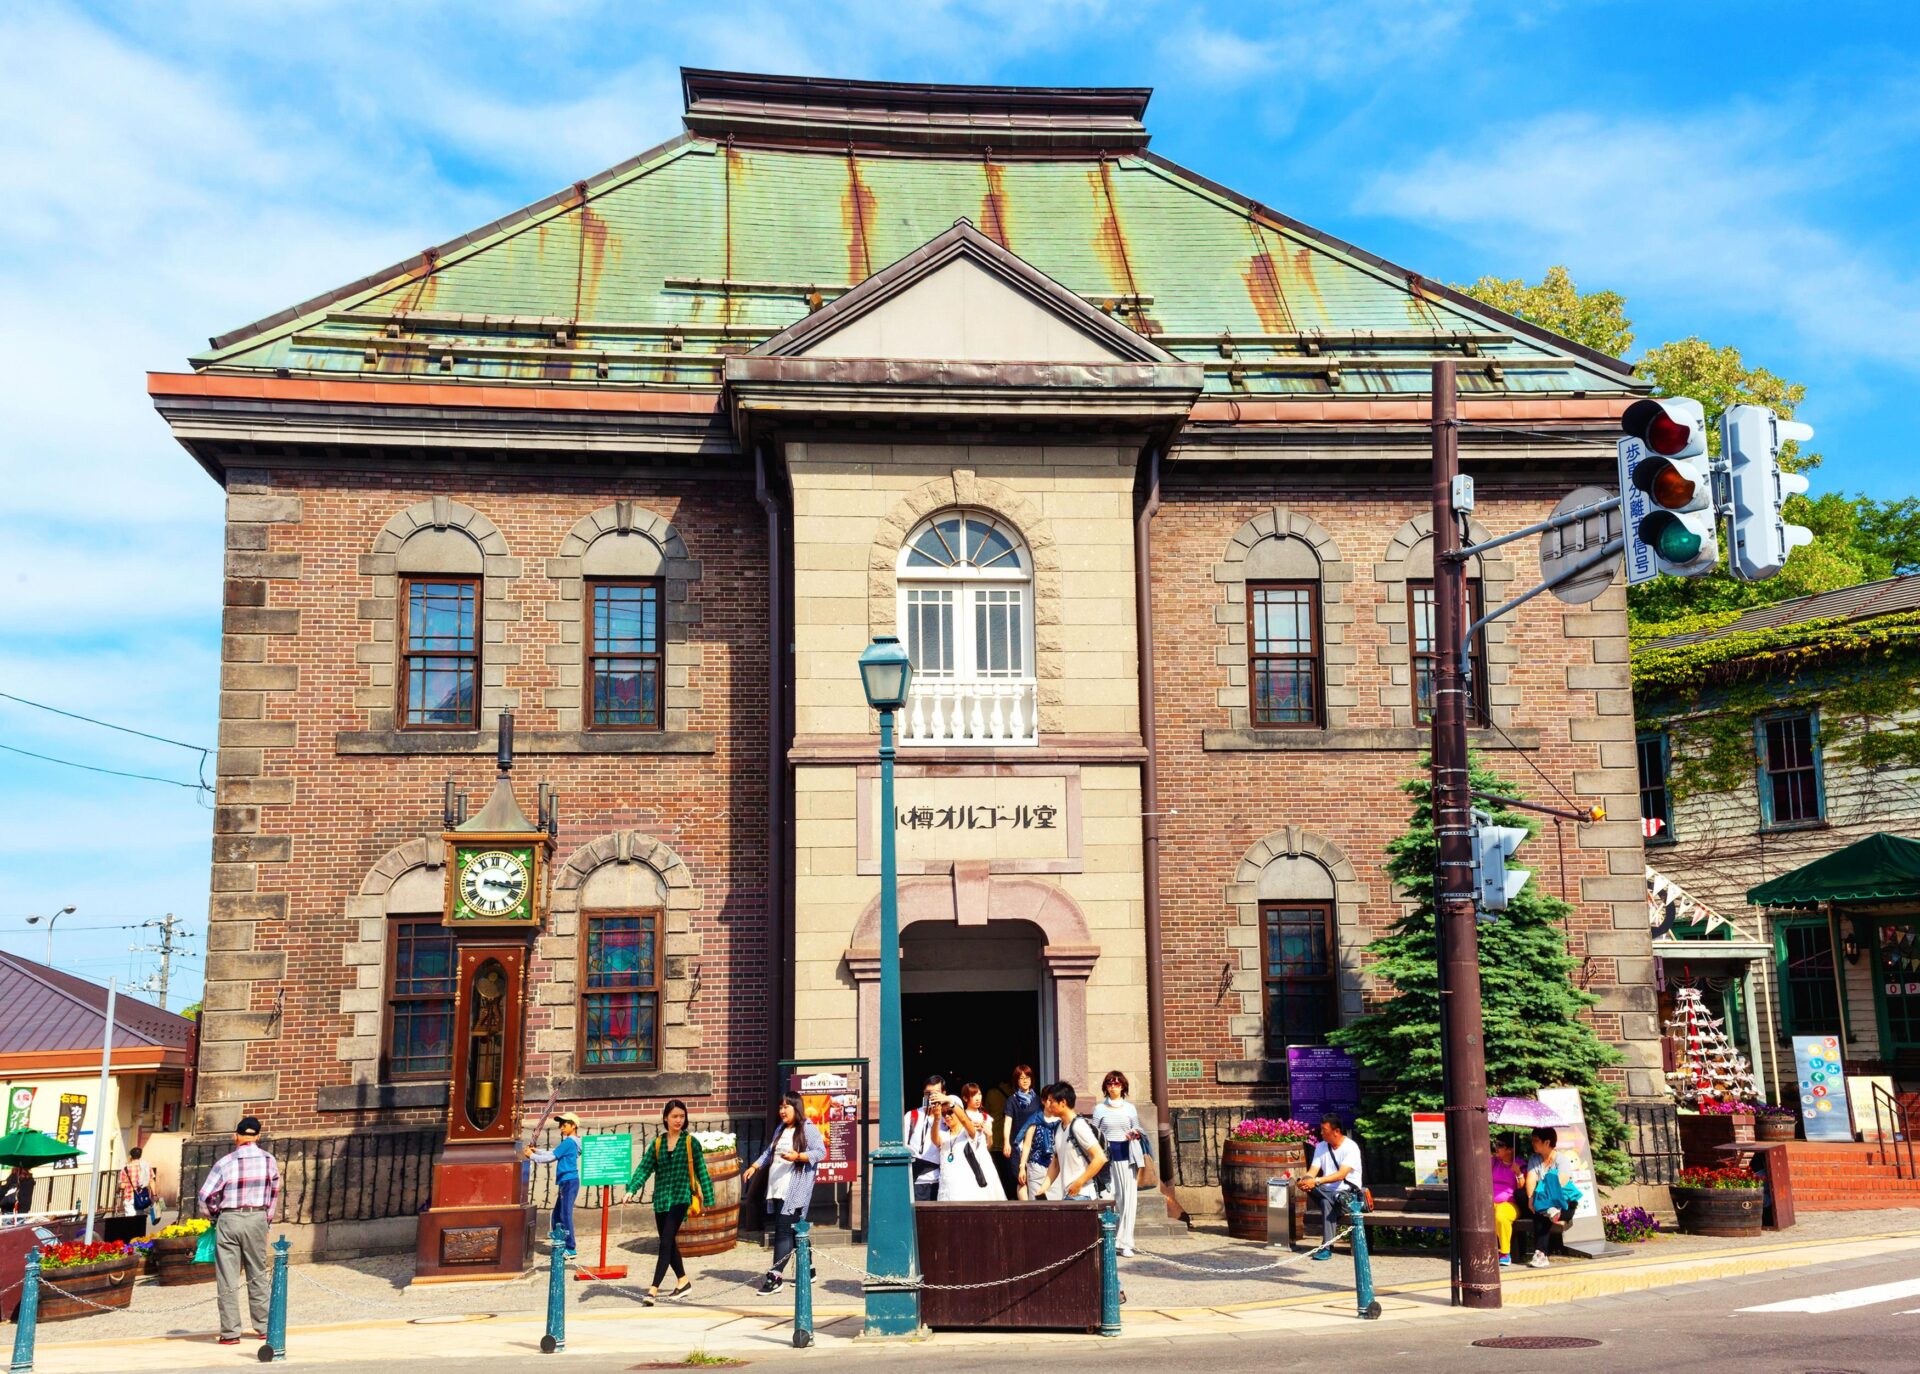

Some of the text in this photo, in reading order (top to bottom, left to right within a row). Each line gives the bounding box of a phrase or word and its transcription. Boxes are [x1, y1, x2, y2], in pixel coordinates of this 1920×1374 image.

[895, 805, 1057, 830] 小樽オルゴール堂
[491, 857, 500, 866] XII
